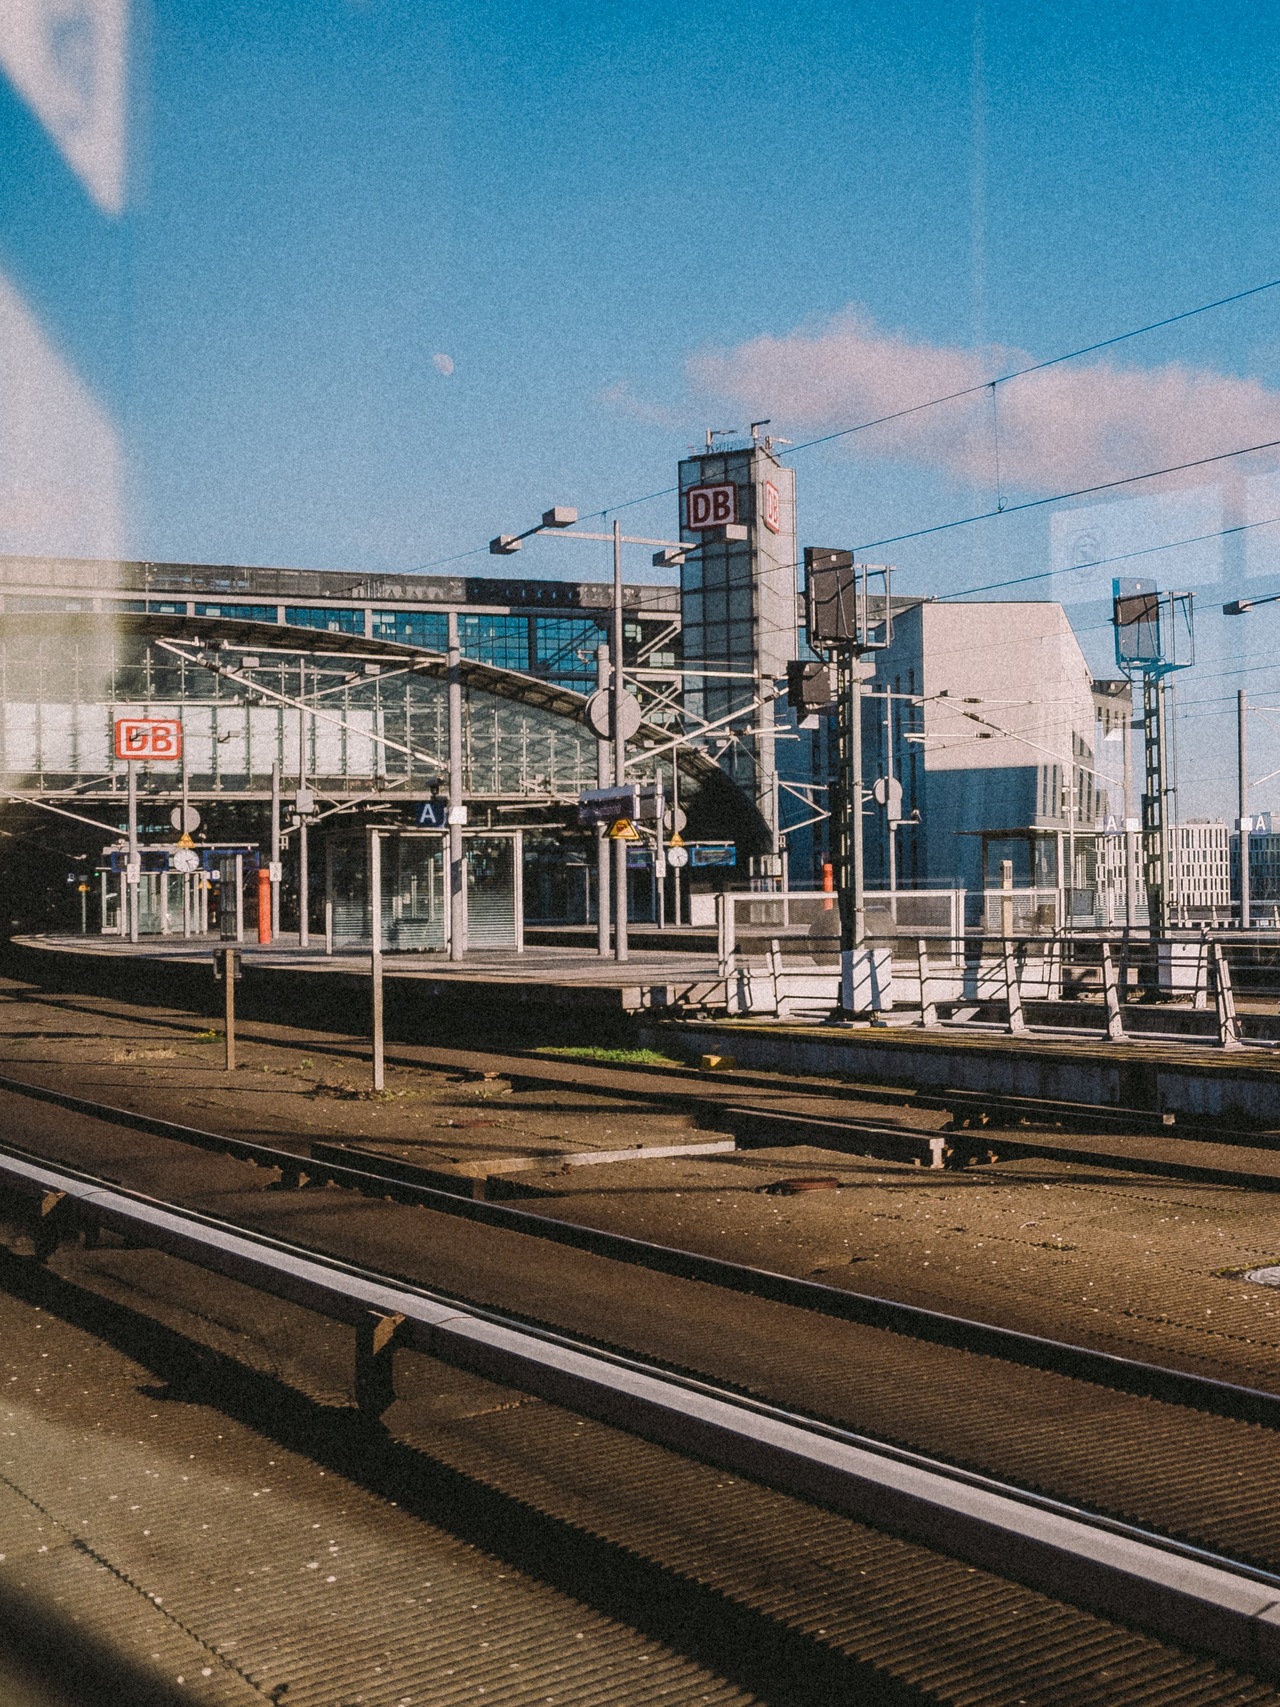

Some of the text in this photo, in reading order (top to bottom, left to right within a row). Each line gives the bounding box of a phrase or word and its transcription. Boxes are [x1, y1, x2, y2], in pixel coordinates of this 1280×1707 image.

[692, 490, 731, 524] DB
[126, 726, 172, 752] DB
[419, 803, 437, 823] A
[1106, 815, 1118, 832] A
[1255, 815, 1267, 831] A
[212, 870, 221, 879] B
